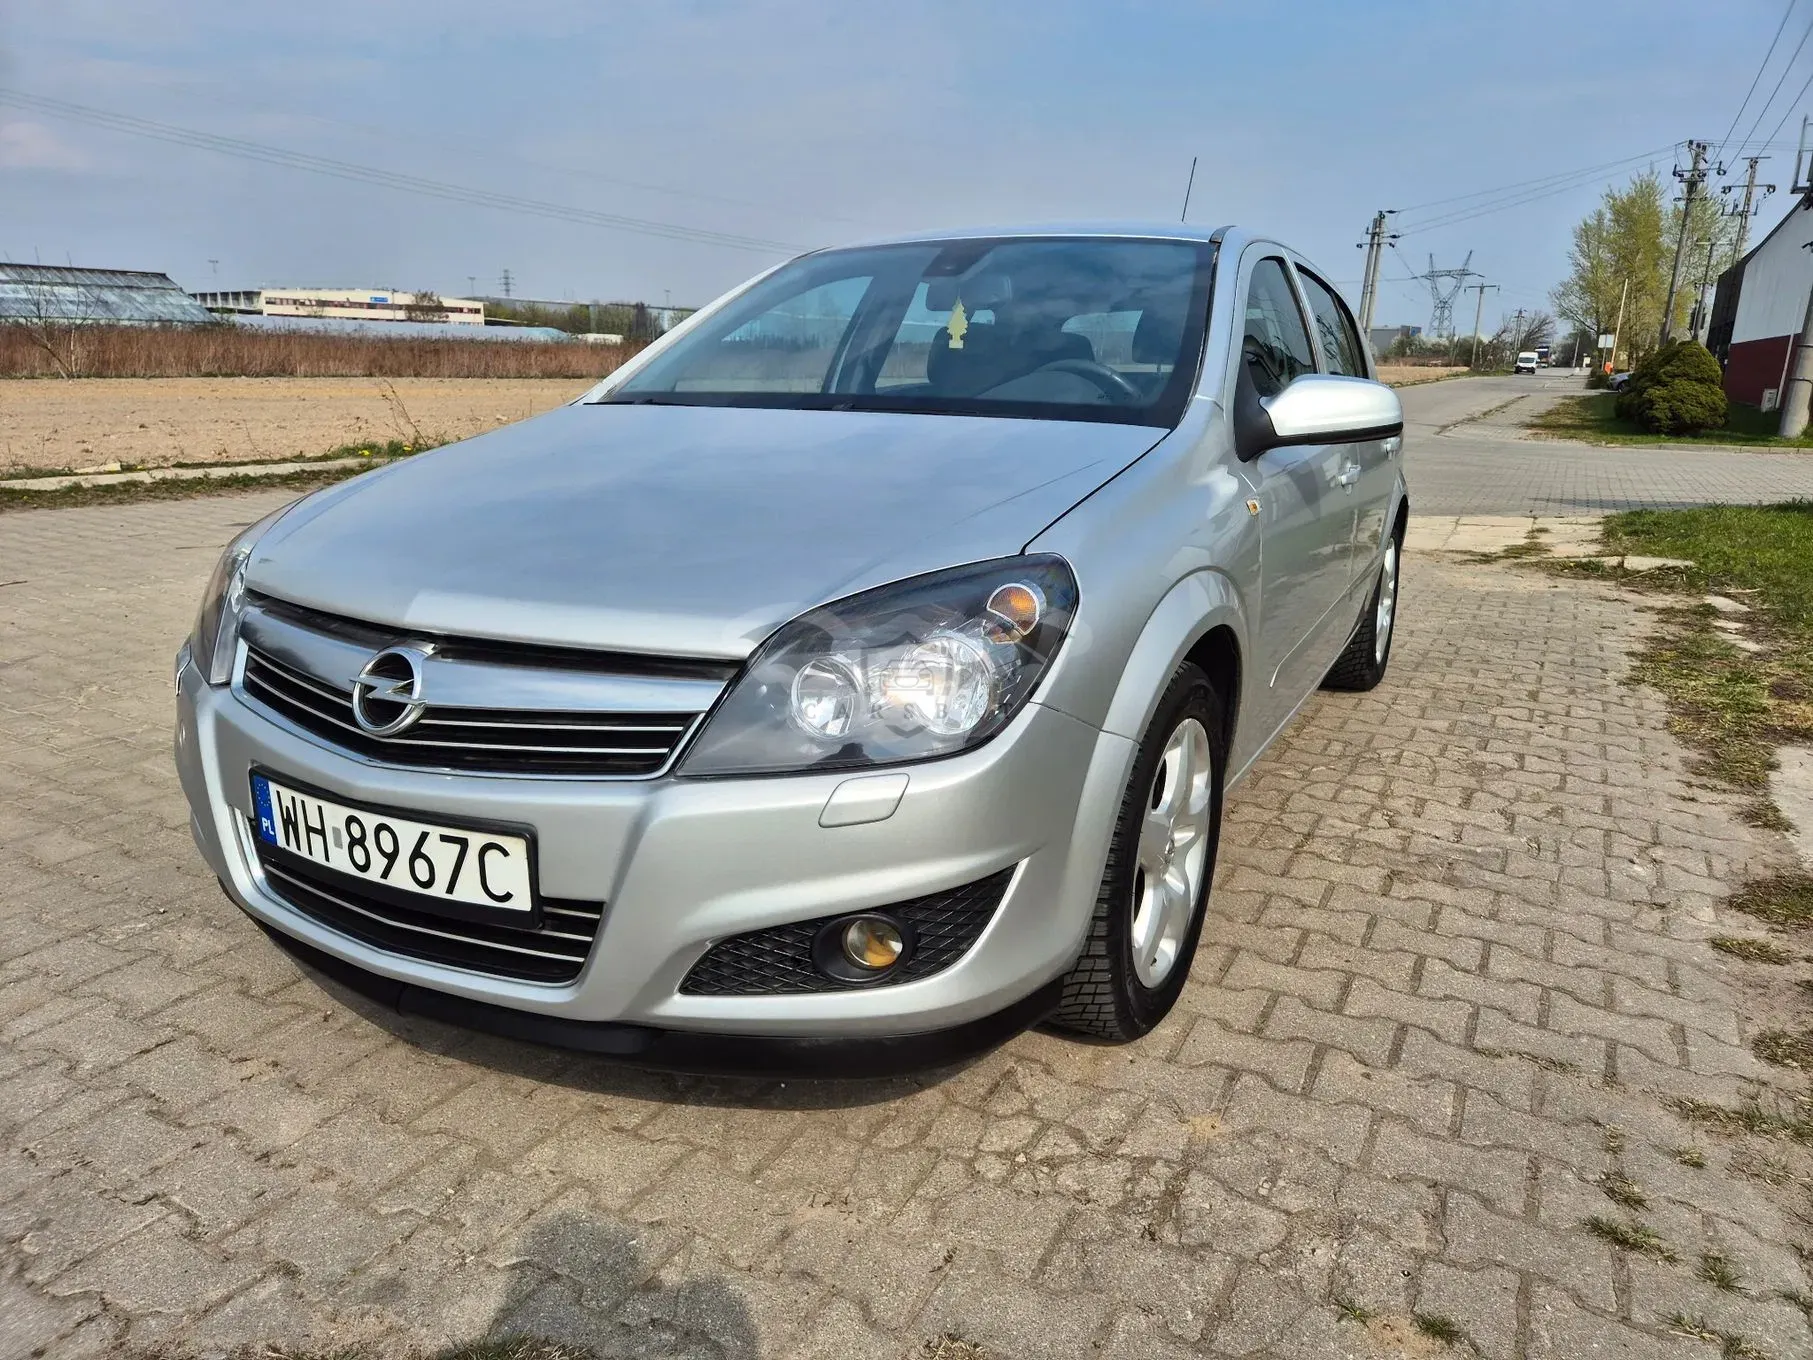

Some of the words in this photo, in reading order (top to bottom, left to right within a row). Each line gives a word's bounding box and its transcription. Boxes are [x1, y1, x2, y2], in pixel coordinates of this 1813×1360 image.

[261, 816, 275, 836] PL
[276, 790, 330, 862] WH
[345, 815, 514, 903] 8967C
